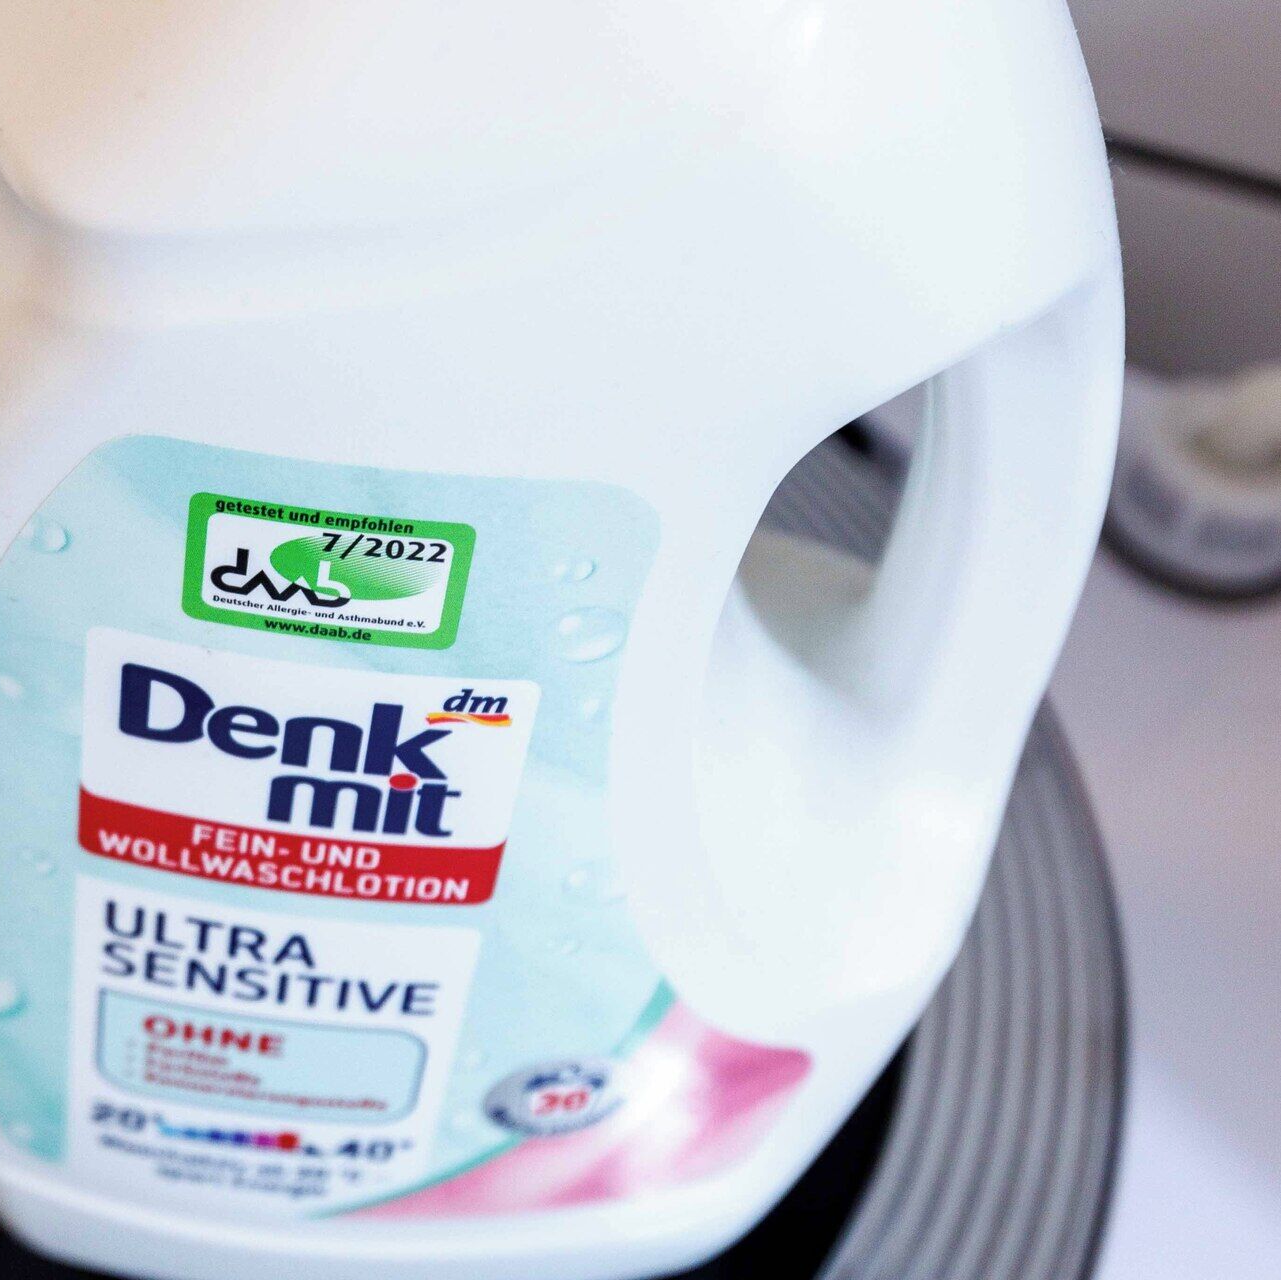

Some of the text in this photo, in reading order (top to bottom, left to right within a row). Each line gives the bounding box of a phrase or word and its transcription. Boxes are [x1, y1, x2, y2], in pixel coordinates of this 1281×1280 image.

[215, 497, 415, 535] getestet und empfohlen
[322, 532, 448, 563] 7/2022
[213, 594, 426, 629] Deutscher Allergie- und Asthmabund e.V.
[264, 619, 372, 642] www.daab.de
[118, 662, 454, 781] Denk
[442, 688, 510, 716] dm
[266, 771, 462, 838] mit
[98, 829, 470, 902] WOLLWASCHLOTION
[191, 824, 381, 871] FEIN- UND
[104, 900, 316, 969] ULTRA
[101, 941, 440, 1016] SENSITIVE
[143, 1015, 287, 1058] OHNE
